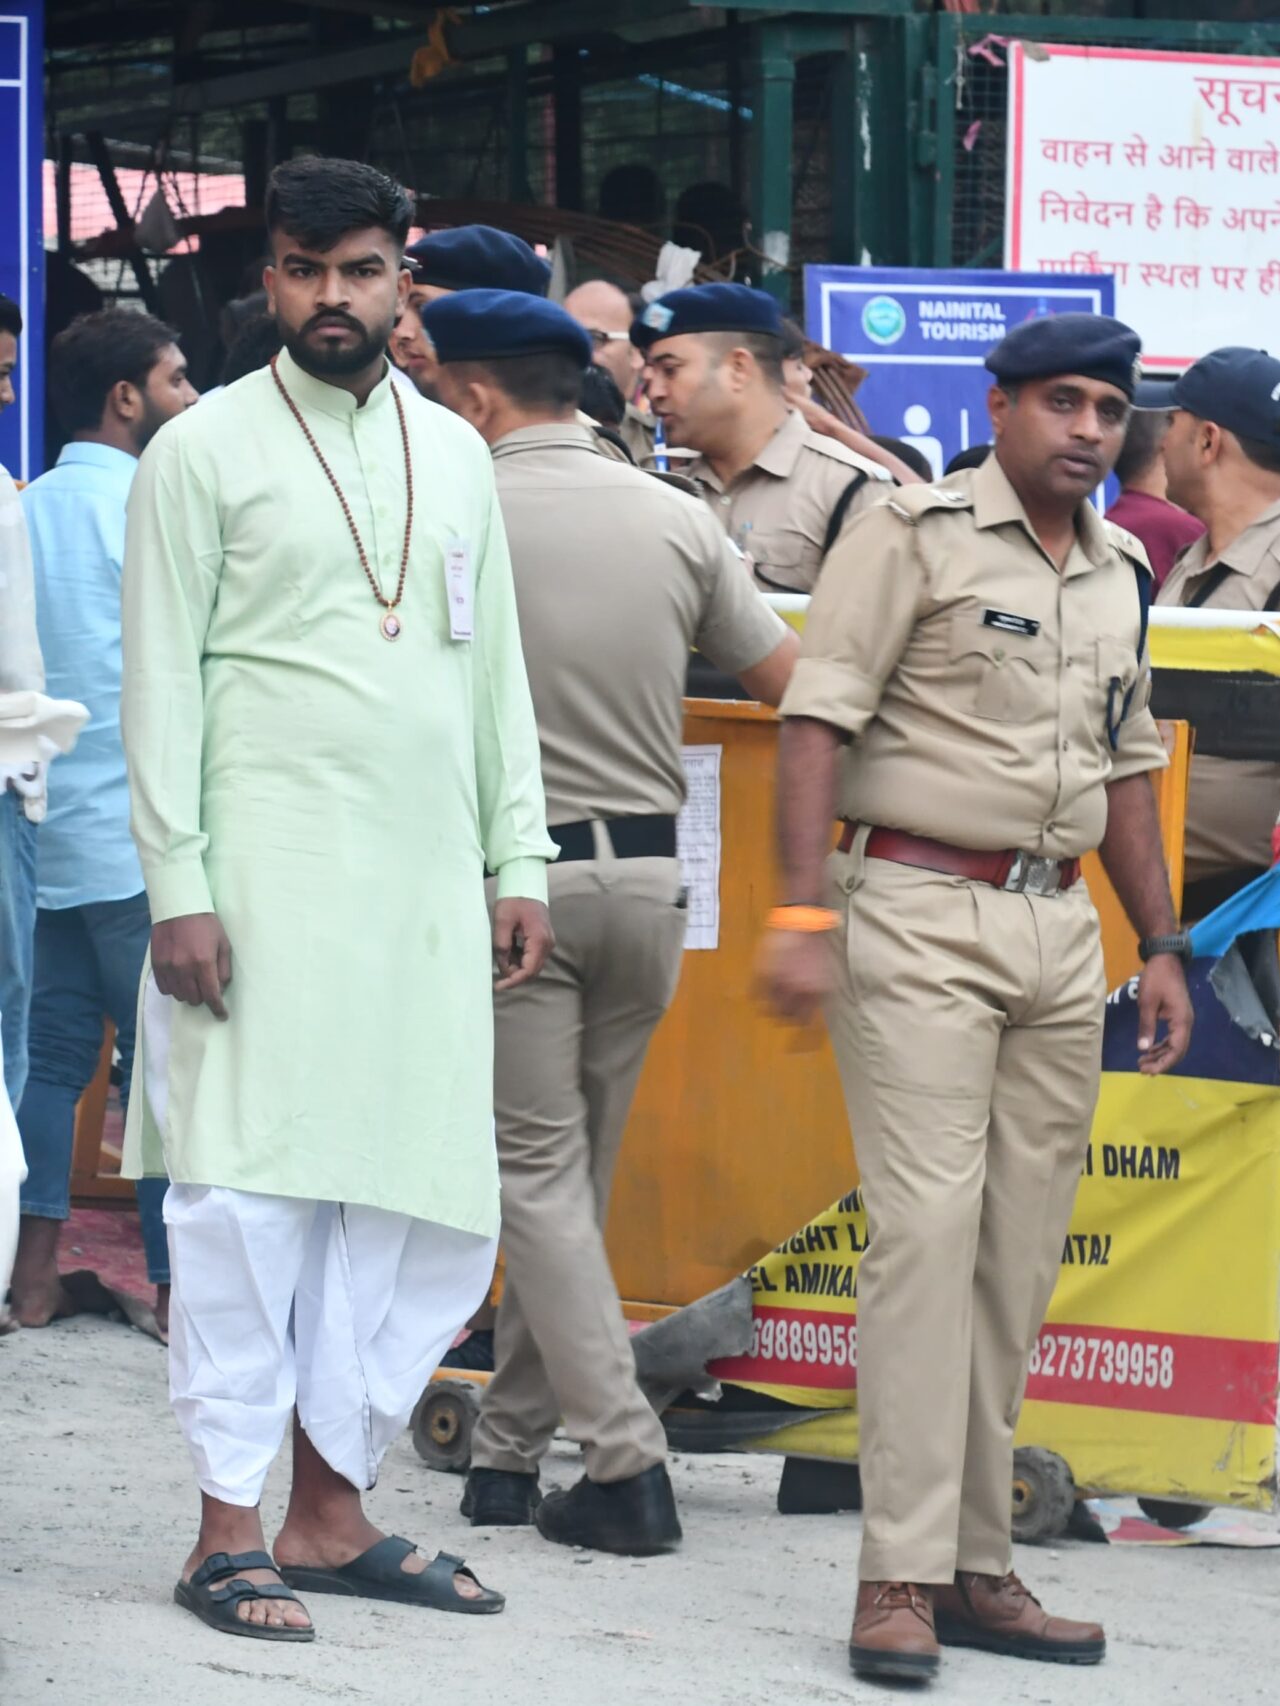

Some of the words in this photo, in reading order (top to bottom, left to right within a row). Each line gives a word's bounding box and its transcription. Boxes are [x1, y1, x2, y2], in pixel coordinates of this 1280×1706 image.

[1041, 138, 1112, 166] वाहन
[1123, 134, 1148, 167] से
[1158, 137, 1216, 171] आने
[1227, 141, 1279, 174] वाले
[1040, 191, 1134, 228] निवेदन
[1143, 190, 1165, 230] है
[1174, 194, 1212, 230] कि
[1139, 260, 1200, 290] स्थल
[1211, 264, 1247, 291] पर
[918, 300, 1007, 321] NAINITAL
[919, 321, 1006, 342] TOURISM
[1102, 1144, 1180, 1180] DHAM
[785, 1263, 858, 1299] AMIKA
